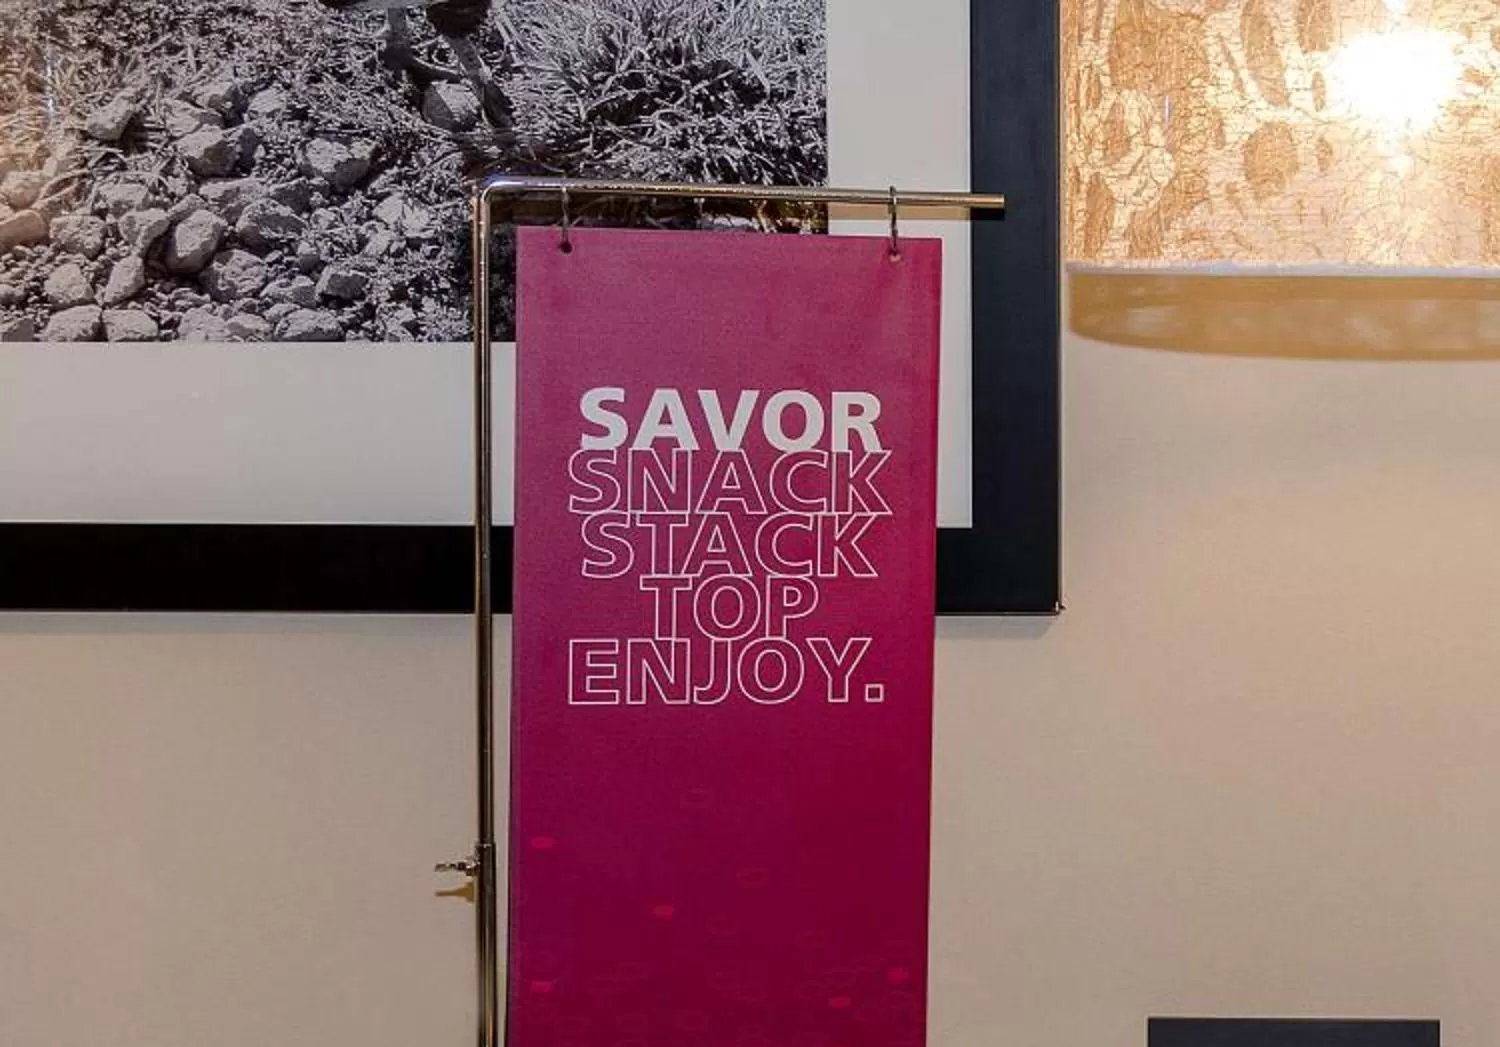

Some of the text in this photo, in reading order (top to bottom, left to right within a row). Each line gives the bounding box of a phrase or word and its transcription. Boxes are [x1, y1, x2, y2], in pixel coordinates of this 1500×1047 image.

[579, 387, 883, 452] SAVOR
[568, 448, 893, 515] SNACK
[581, 511, 878, 579] STACK
[639, 575, 819, 641] TOP
[568, 637, 885, 705] ENJOY.
